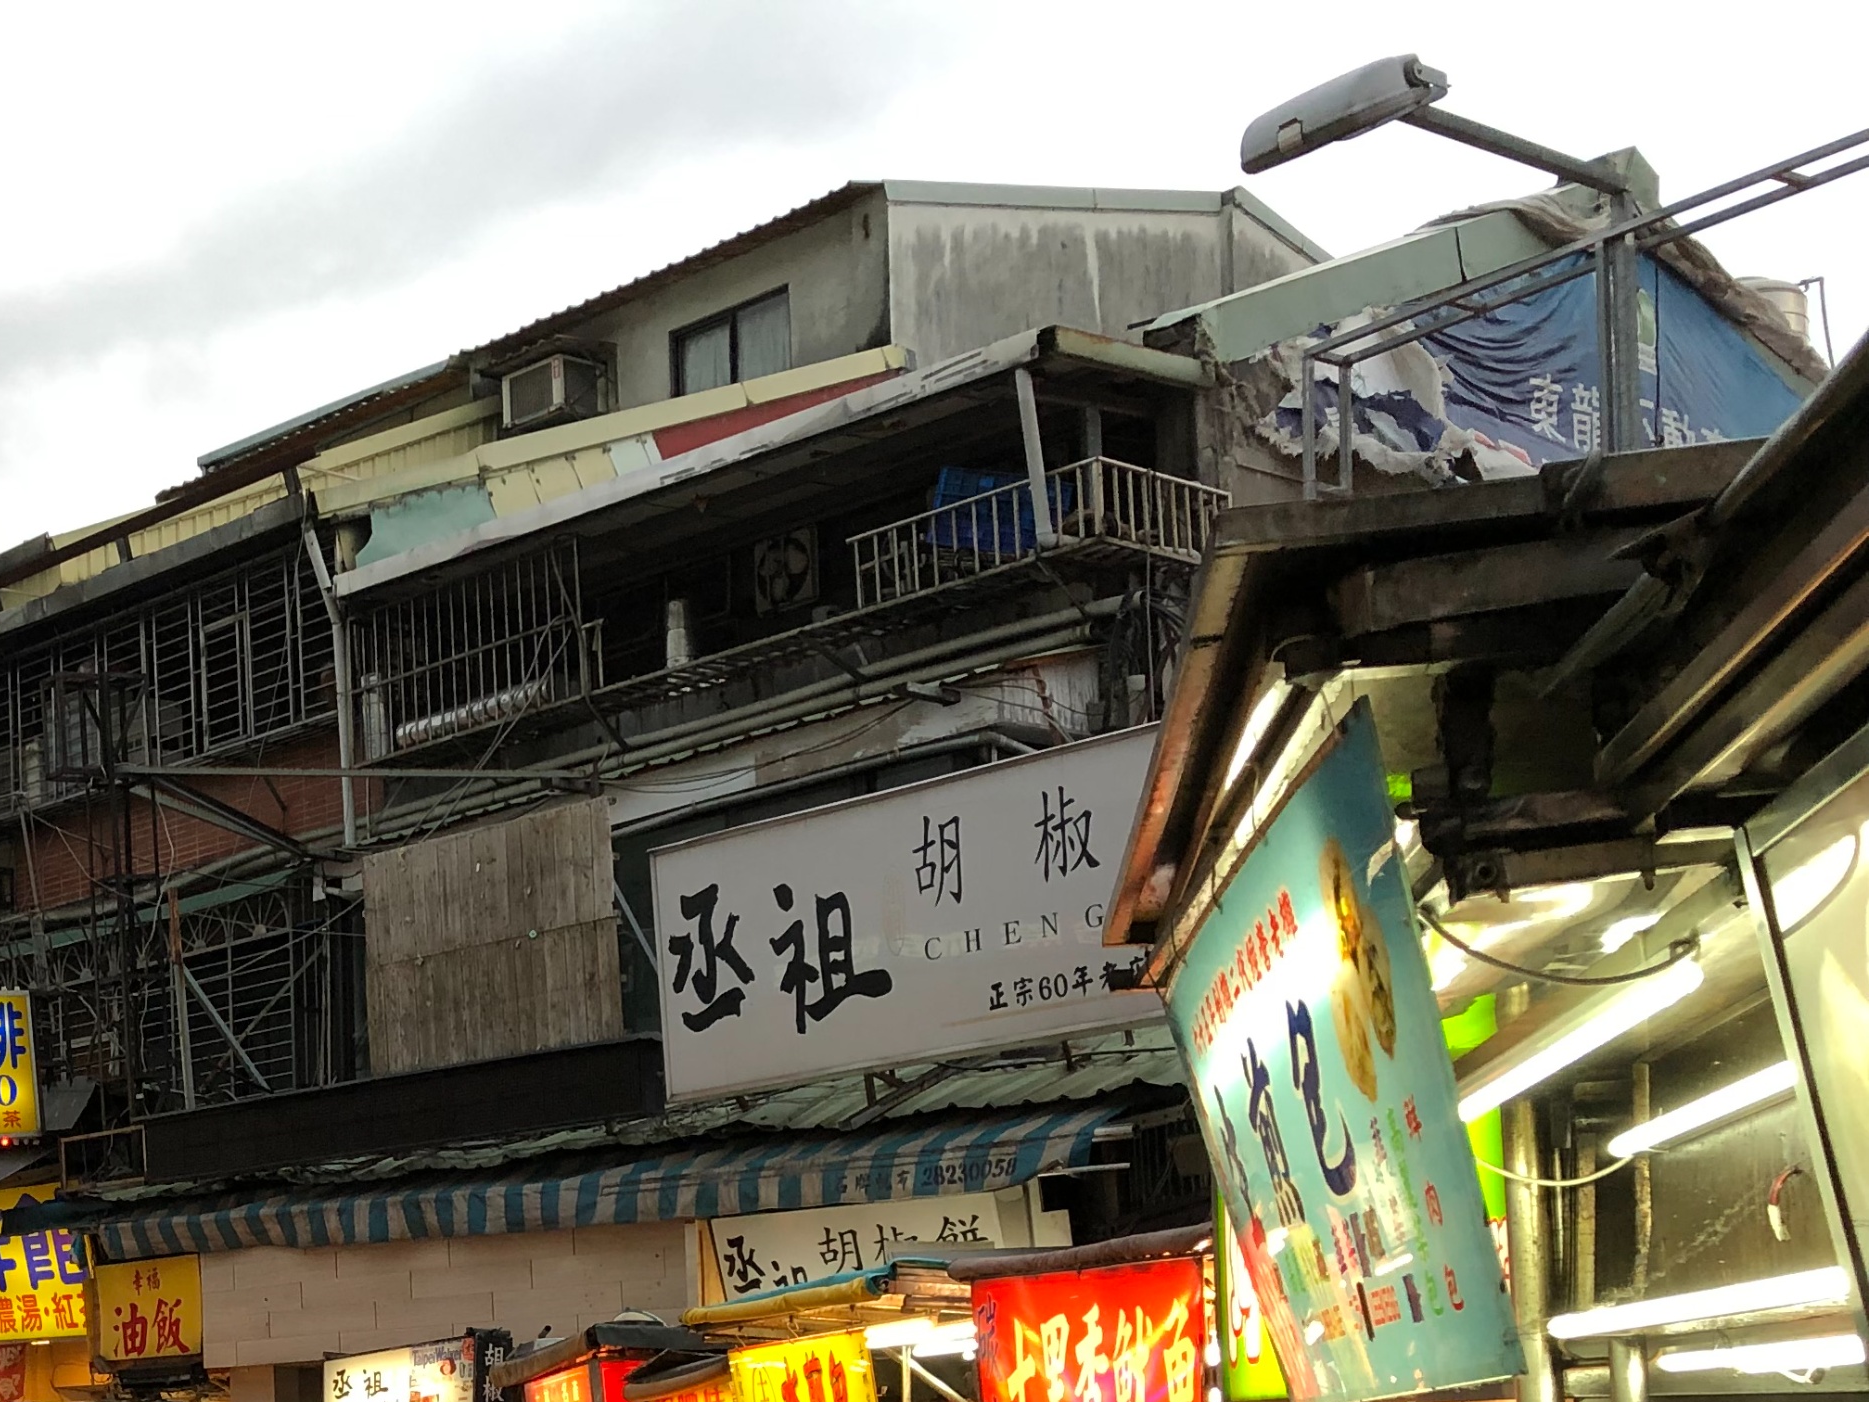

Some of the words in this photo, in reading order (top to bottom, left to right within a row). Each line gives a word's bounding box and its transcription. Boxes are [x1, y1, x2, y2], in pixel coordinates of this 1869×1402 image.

[912, 785, 1100, 907] 胡椒
[668, 884, 893, 1034] 丞祖
[132, 1267, 162, 1296] 幸福
[113, 1298, 191, 1358] 油飯
[332, 1367, 389, 1399] 丞祖
